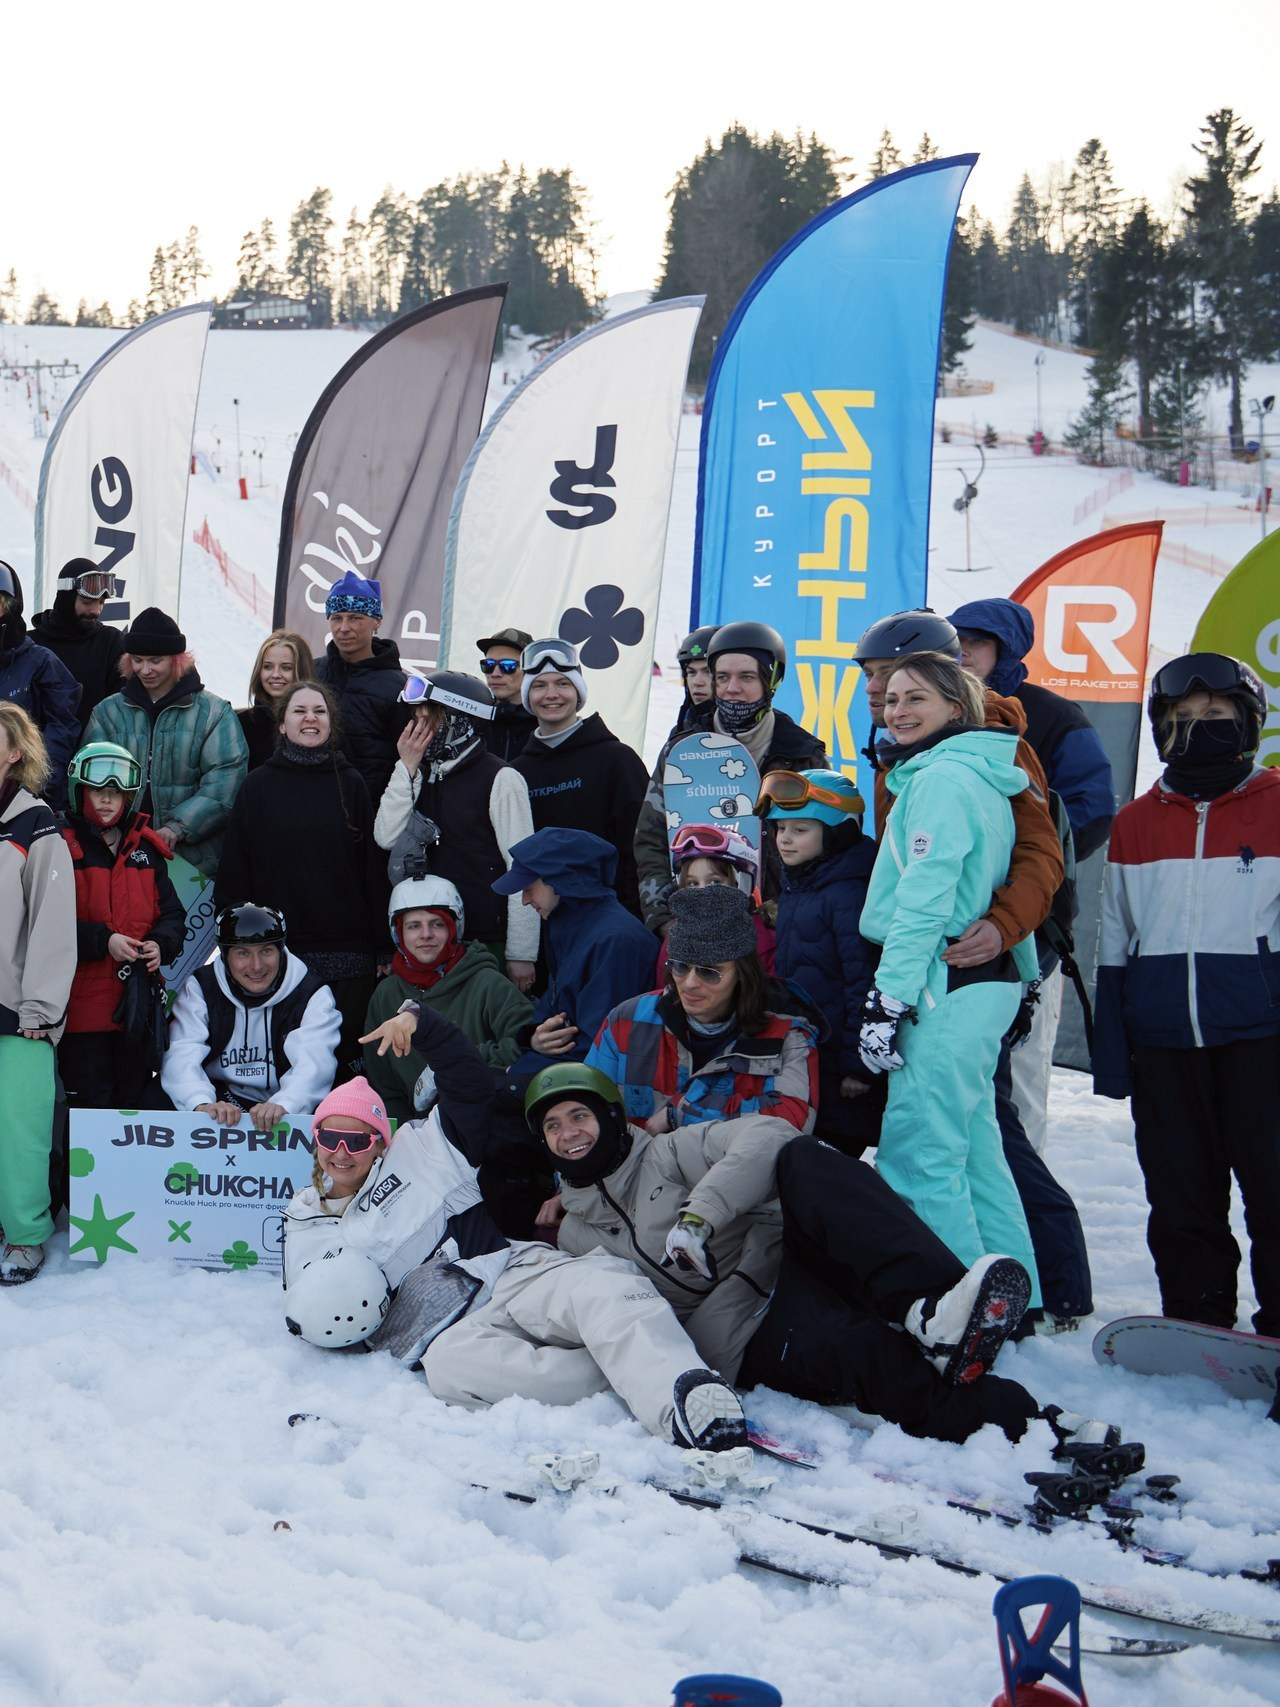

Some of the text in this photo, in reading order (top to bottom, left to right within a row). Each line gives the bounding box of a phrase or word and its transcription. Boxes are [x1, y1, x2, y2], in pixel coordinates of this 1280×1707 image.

[752, 398, 778, 587] КУРОРТ
[90, 456, 136, 633] ING
[780, 389, 876, 786] ЖНЫЙ
[1040, 677, 1139, 689] LOS RAKETOS
[443, 694, 478, 712] SMITH
[528, 777, 582, 798] ОТКРЫВАЙ
[220, 1046, 275, 1069] GORILL
[235, 1066, 266, 1077] ENERGY
[111, 1124, 175, 1148] JIB
[163, 1172, 295, 1200] CHUKCHA
[372, 1177, 397, 1203] NASA
[164, 1198, 195, 1207] Knuckle
[624, 1294, 637, 1302] THE
